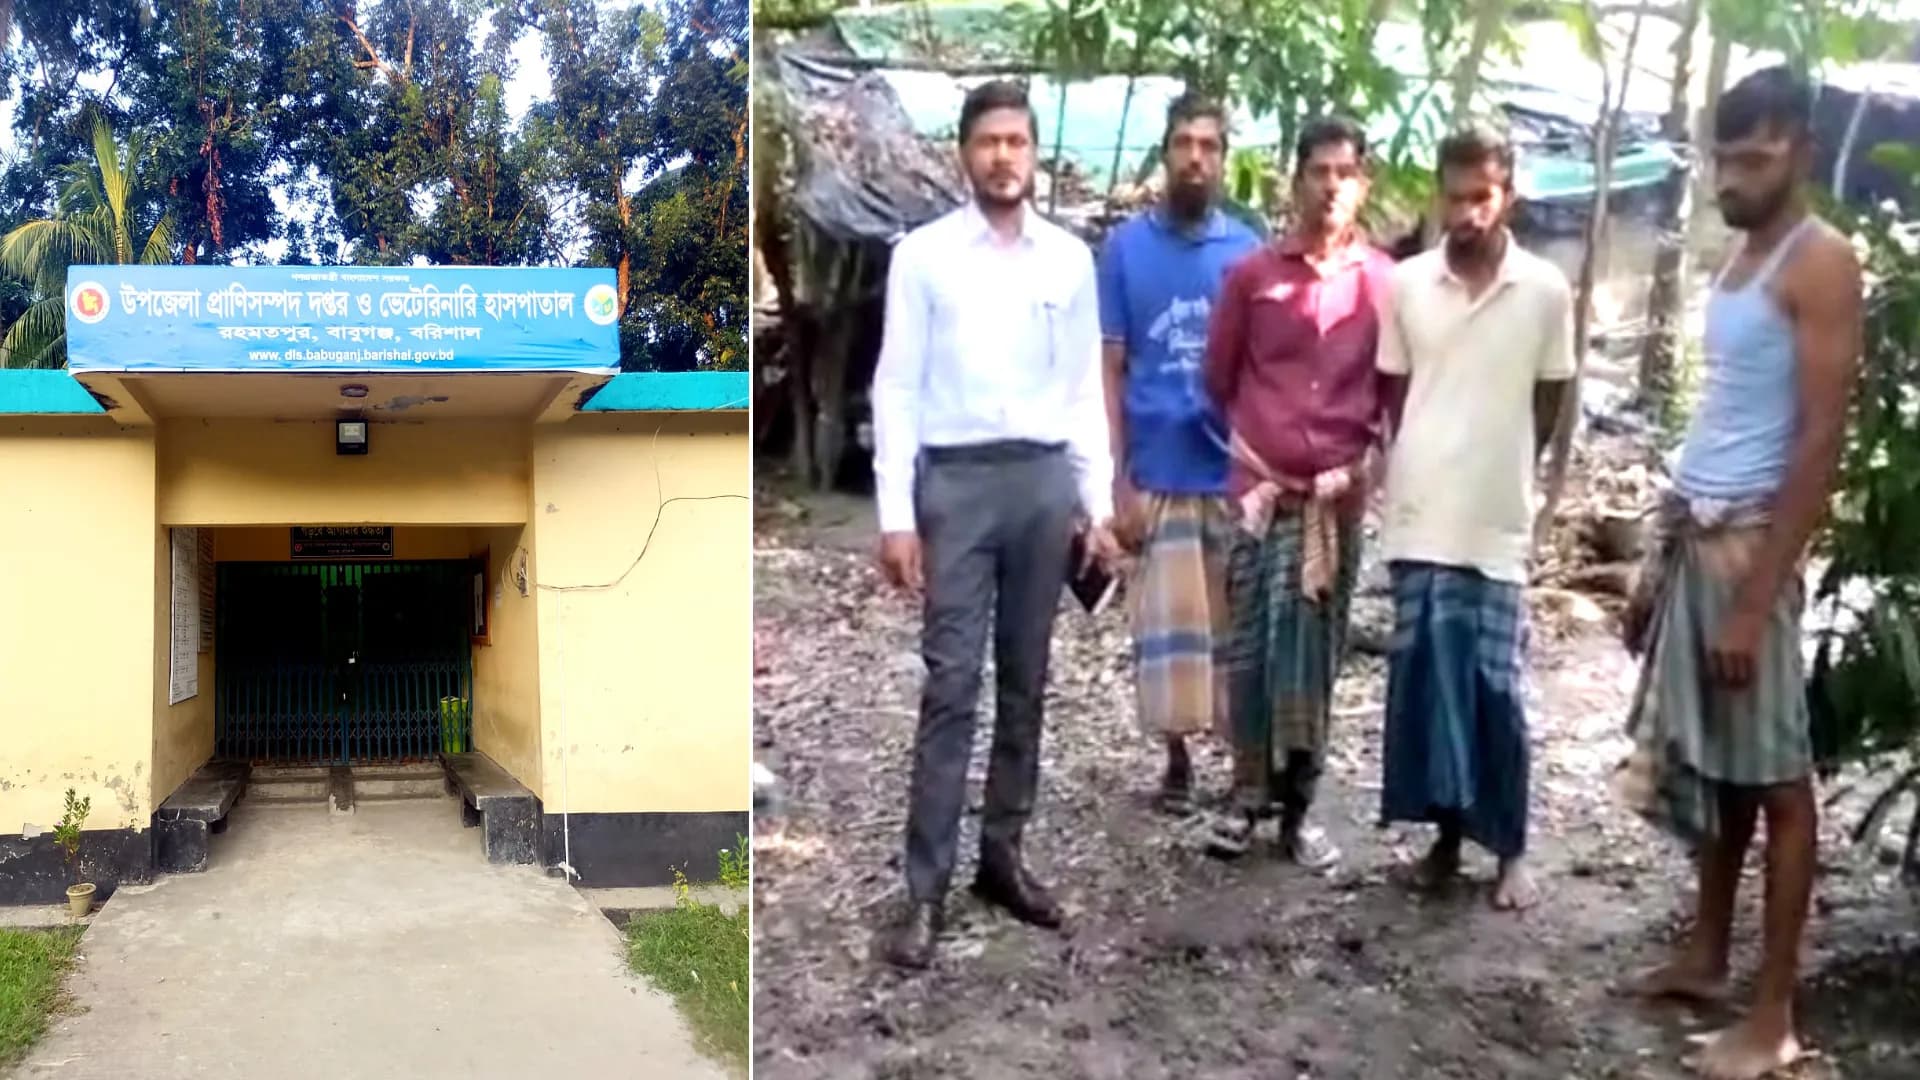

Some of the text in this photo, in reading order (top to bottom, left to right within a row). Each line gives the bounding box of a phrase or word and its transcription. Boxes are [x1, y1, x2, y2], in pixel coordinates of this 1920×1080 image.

[118, 280, 576, 321] উপজেলা প্রাণিসম্পদ দপ্তর ও ভেটেরিনারি হাসপাতাল
[217, 323, 484, 343] রহমতপুর, বাবুগঞ্জ, বরিশাল
[249, 349, 454, 364] www. dls.babuganj.barishal.gov.bd
